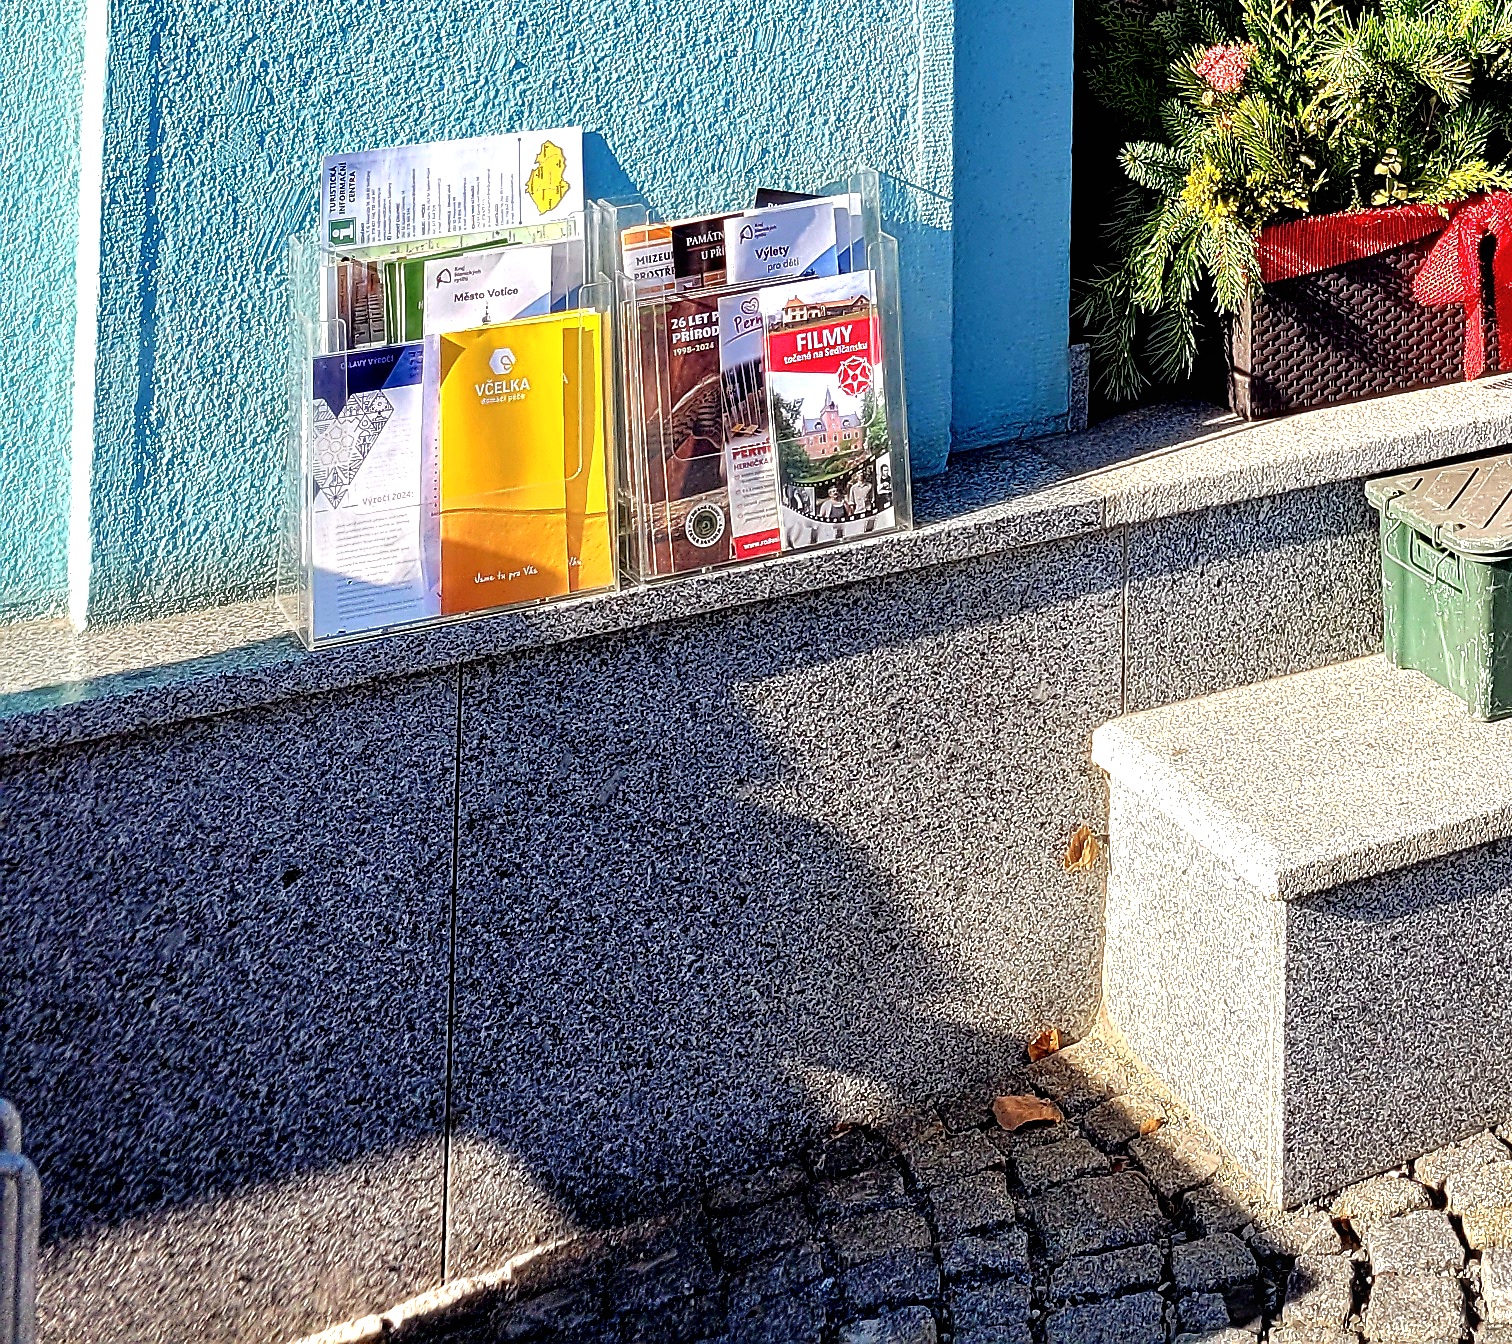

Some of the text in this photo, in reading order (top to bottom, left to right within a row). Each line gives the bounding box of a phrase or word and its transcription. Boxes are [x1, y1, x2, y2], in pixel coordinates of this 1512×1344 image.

[338, 161, 347, 215] INFORMAČNÍ
[348, 170, 356, 203] CENTRA
[635, 251, 674, 266] MUZEU
[701, 250, 709, 261] U
[754, 245, 790, 262] Výlety
[767, 262, 782, 273] pro
[453, 291, 485, 303] Město
[670, 317, 687, 330] 26
[688, 312, 710, 327] LET
[796, 324, 853, 352] FILMY
[783, 341, 868, 365] točené na Sedlčansku
[474, 377, 531, 397] VČELKA
